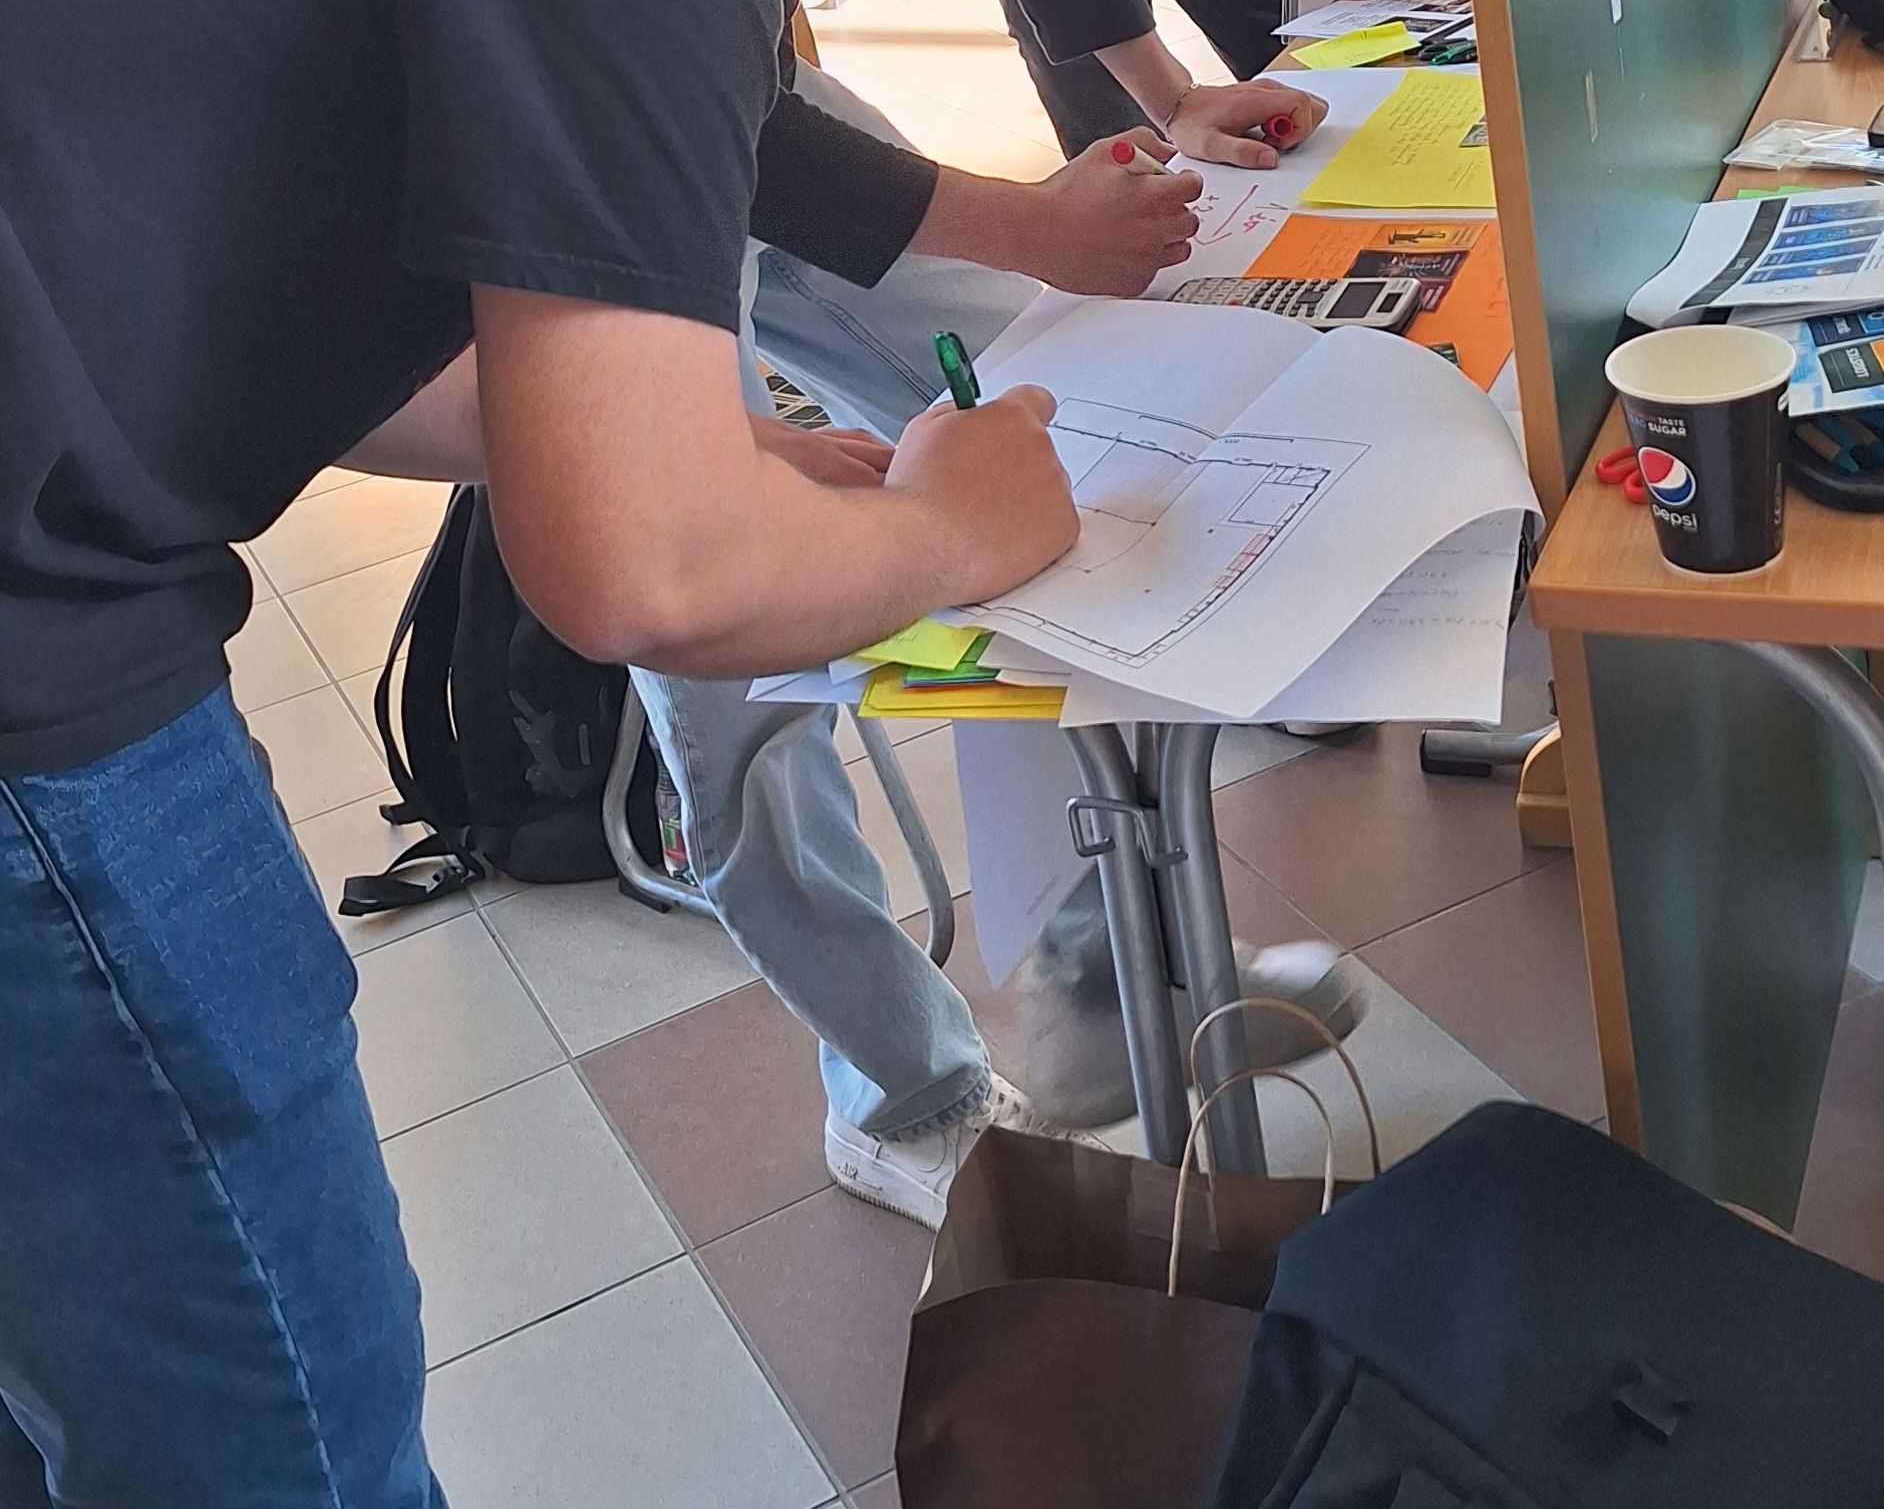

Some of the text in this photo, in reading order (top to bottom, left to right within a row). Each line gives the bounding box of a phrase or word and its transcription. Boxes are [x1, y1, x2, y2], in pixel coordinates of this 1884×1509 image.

[1647, 421, 1687, 437] SUGAR
[1657, 417, 1685, 427] TASTE
[1652, 503, 1698, 528] pepsi
